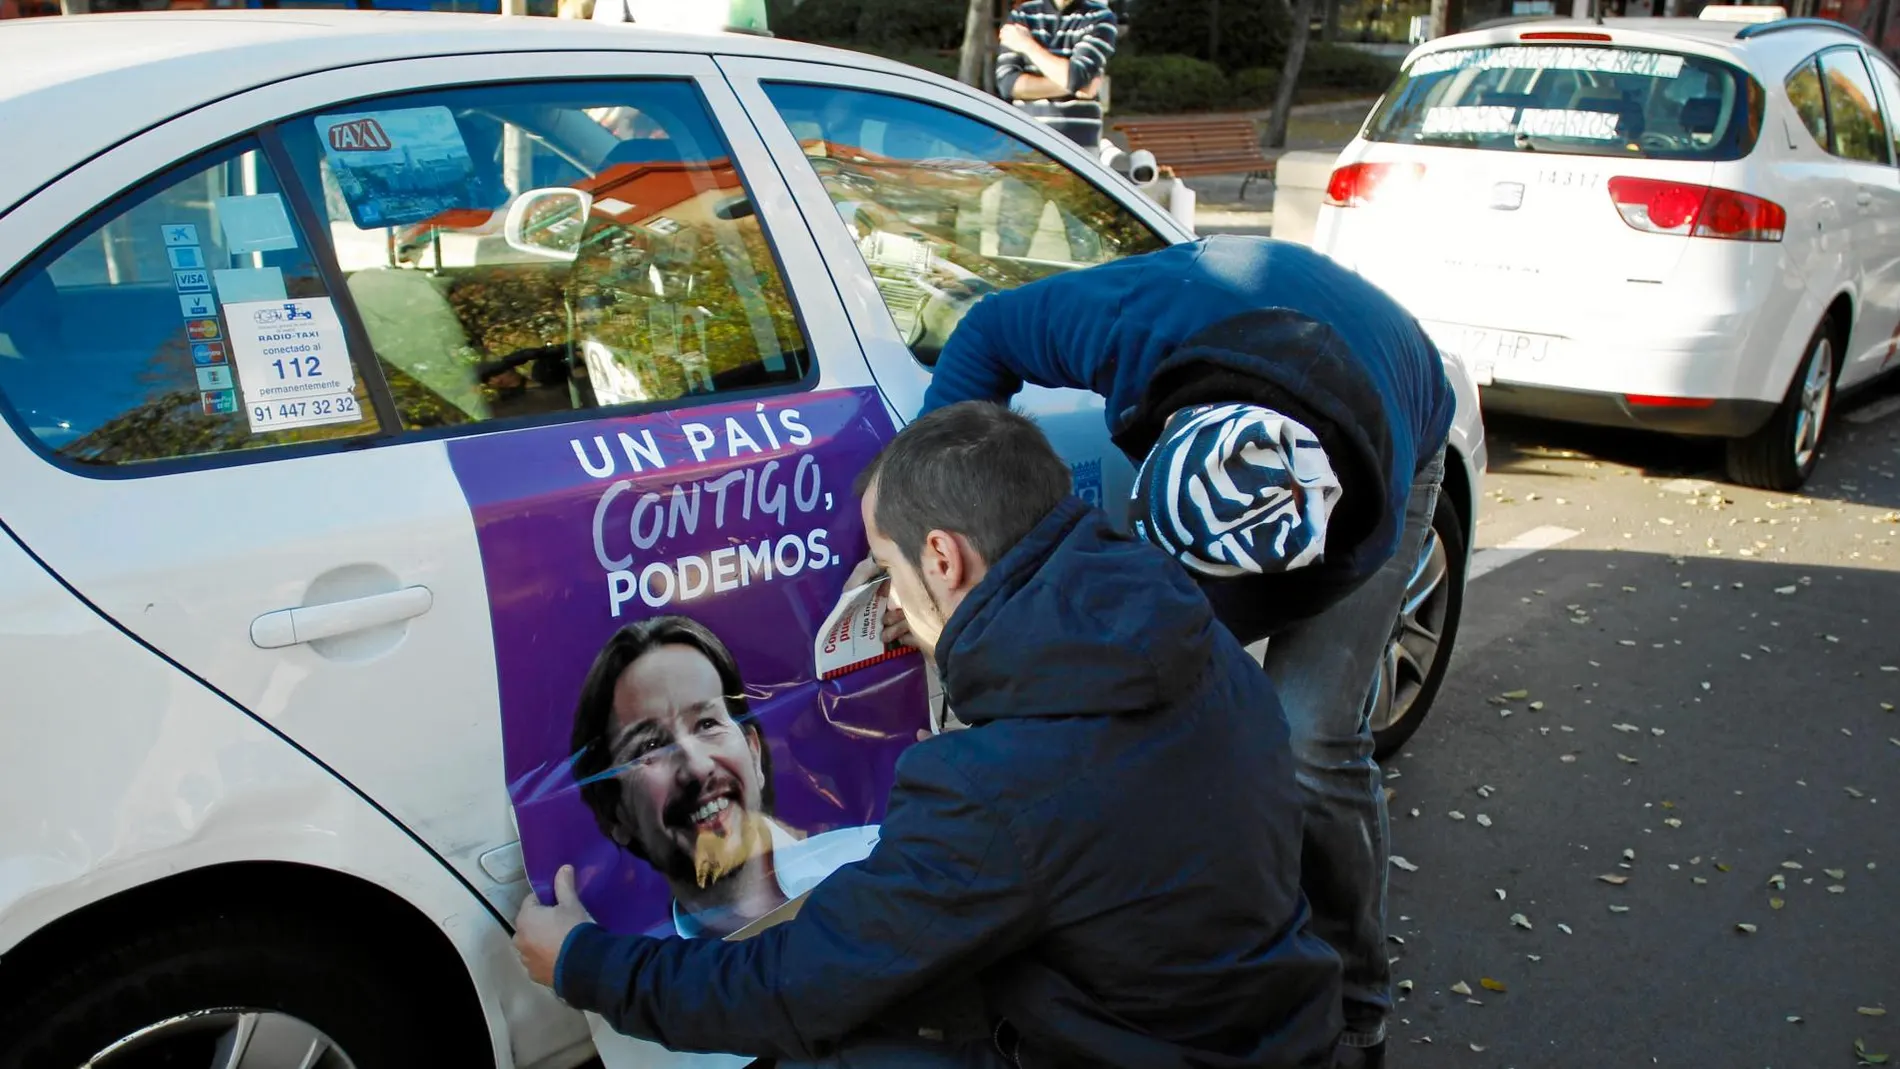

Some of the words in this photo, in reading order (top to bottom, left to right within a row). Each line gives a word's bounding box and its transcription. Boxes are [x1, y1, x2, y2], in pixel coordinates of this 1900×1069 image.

[332, 121, 388, 149] TAXI
[1538, 169, 1599, 189] 14317
[180, 273, 205, 285] VISA
[258, 331, 320, 342] RADIO-TAXI
[1496, 333, 1550, 362] HPJ
[262, 344, 311, 356] conectado
[313, 342, 321, 351] al
[272, 356, 322, 380] 112
[259, 380, 341, 396] permanentemente
[254, 405, 272, 422] 91
[279, 402, 306, 418] 447
[312, 399, 331, 415] 32
[336, 397, 354, 413] 32
[570, 429, 666, 479] UN
[682, 402, 813, 463] PAÍS
[606, 528, 840, 617] PODEMOS.
